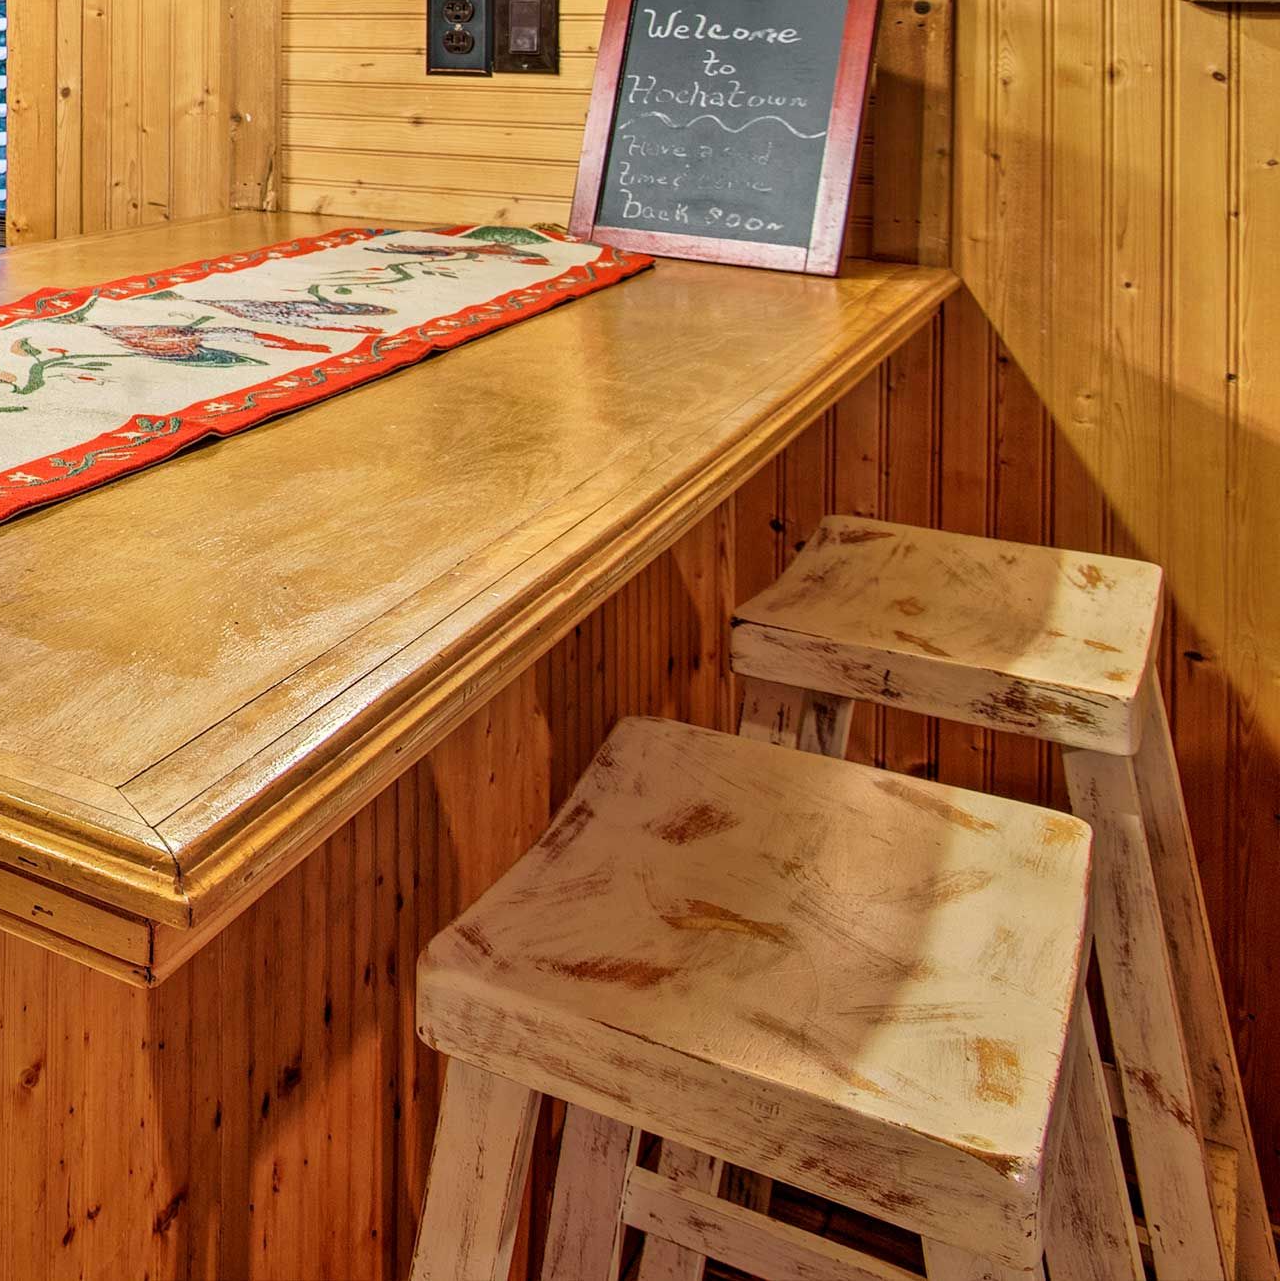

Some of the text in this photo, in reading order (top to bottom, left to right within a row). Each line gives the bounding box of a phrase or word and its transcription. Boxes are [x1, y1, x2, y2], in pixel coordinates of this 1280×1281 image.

[643, 8, 803, 44] Welcome
[702, 49, 737, 77] to
[626, 74, 810, 109] Hochatown
[622, 134, 688, 157] Have
[698, 145, 713, 158] a
